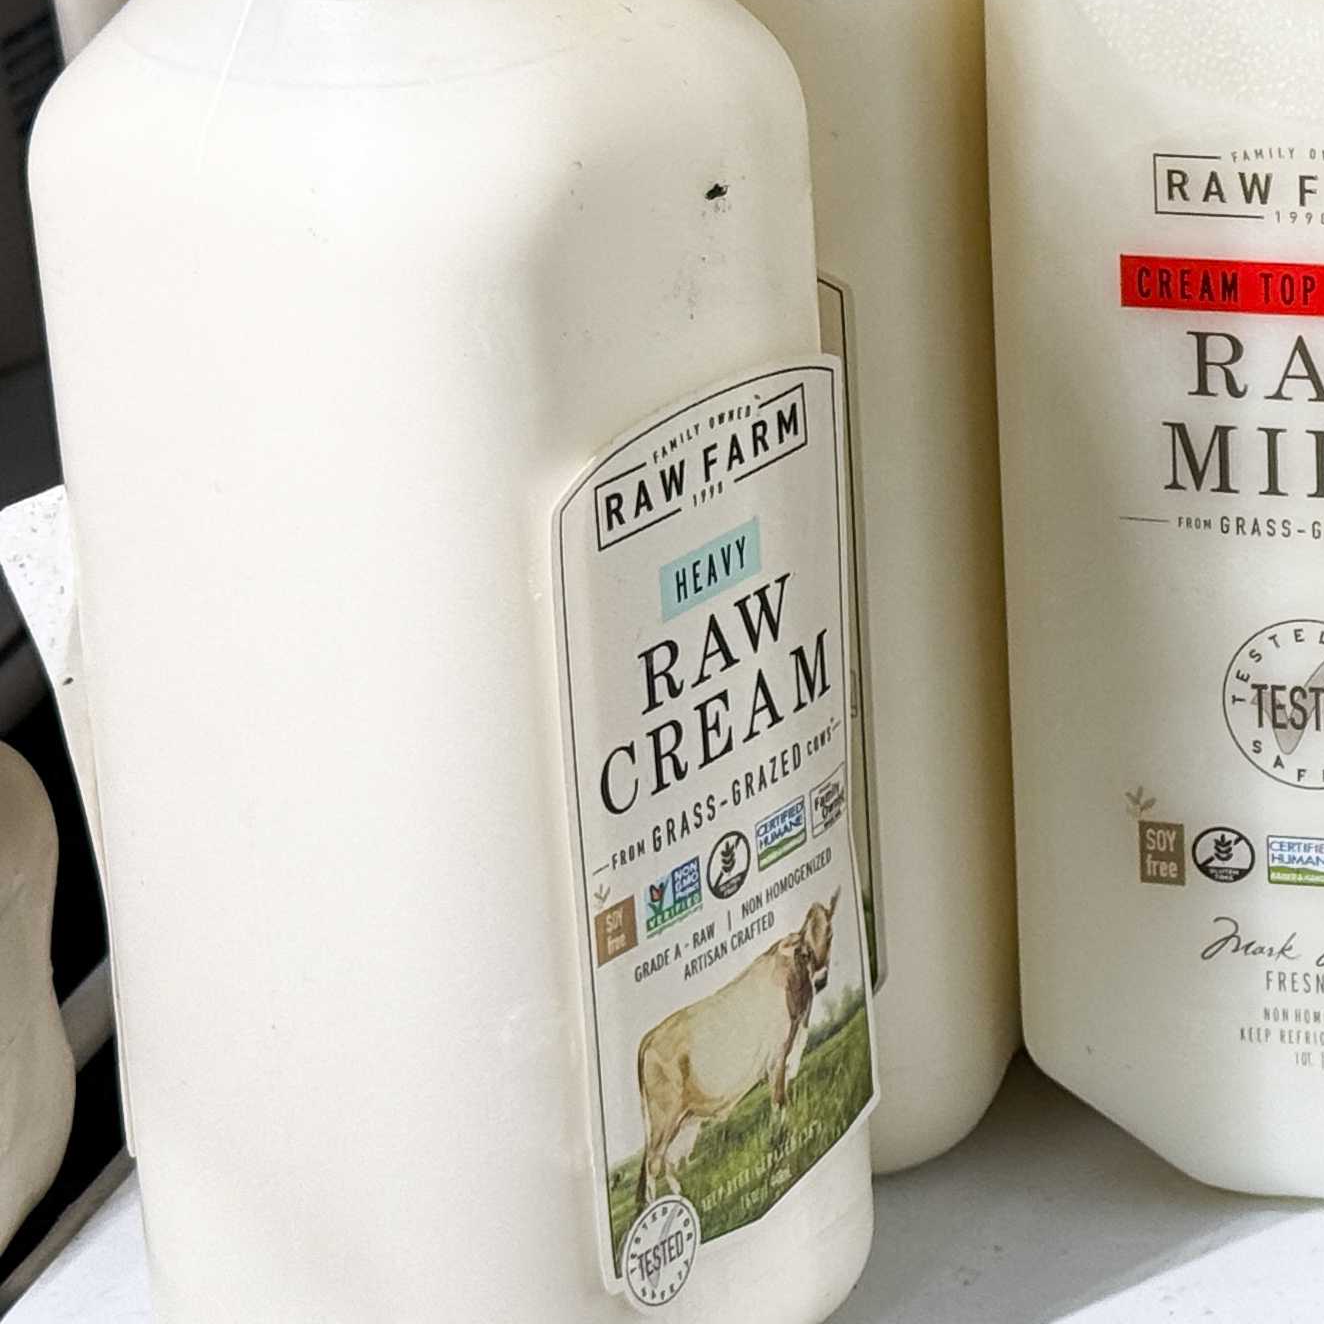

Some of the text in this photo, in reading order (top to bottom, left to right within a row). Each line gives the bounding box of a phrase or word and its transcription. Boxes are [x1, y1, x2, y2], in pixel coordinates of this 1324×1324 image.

[1231, 147, 1296, 163] FAMILY
[1166, 168, 1274, 206] RAW
[1136, 265, 1240, 303] CREAM
[1260, 271, 1317, 307] TOP
[653, 404, 752, 465] FAMILY OWNED
[604, 401, 799, 532] RAW FARM
[1177, 515, 1213, 531] FROM
[675, 535, 746, 604] HEAVY
[638, 572, 792, 716] RAW
[600, 628, 832, 816] CREAM
[611, 840, 645, 871] FROM
[652, 742, 802, 853] GRASS-GRAZED
[1145, 828, 1177, 852] SOY
[1145, 854, 1179, 878] free
[740, 891, 763, 920] NON
[765, 846, 832, 911] HOMOGENIZED
[634, 947, 671, 983] GRADE
[692, 921, 716, 950] RAW
[683, 910, 776, 981] ARTISAN CRAFTED
[1201, 916, 1301, 962] Mark
[1263, 1006, 1290, 1023] NON
[637, 1229, 684, 1282] TESTED
